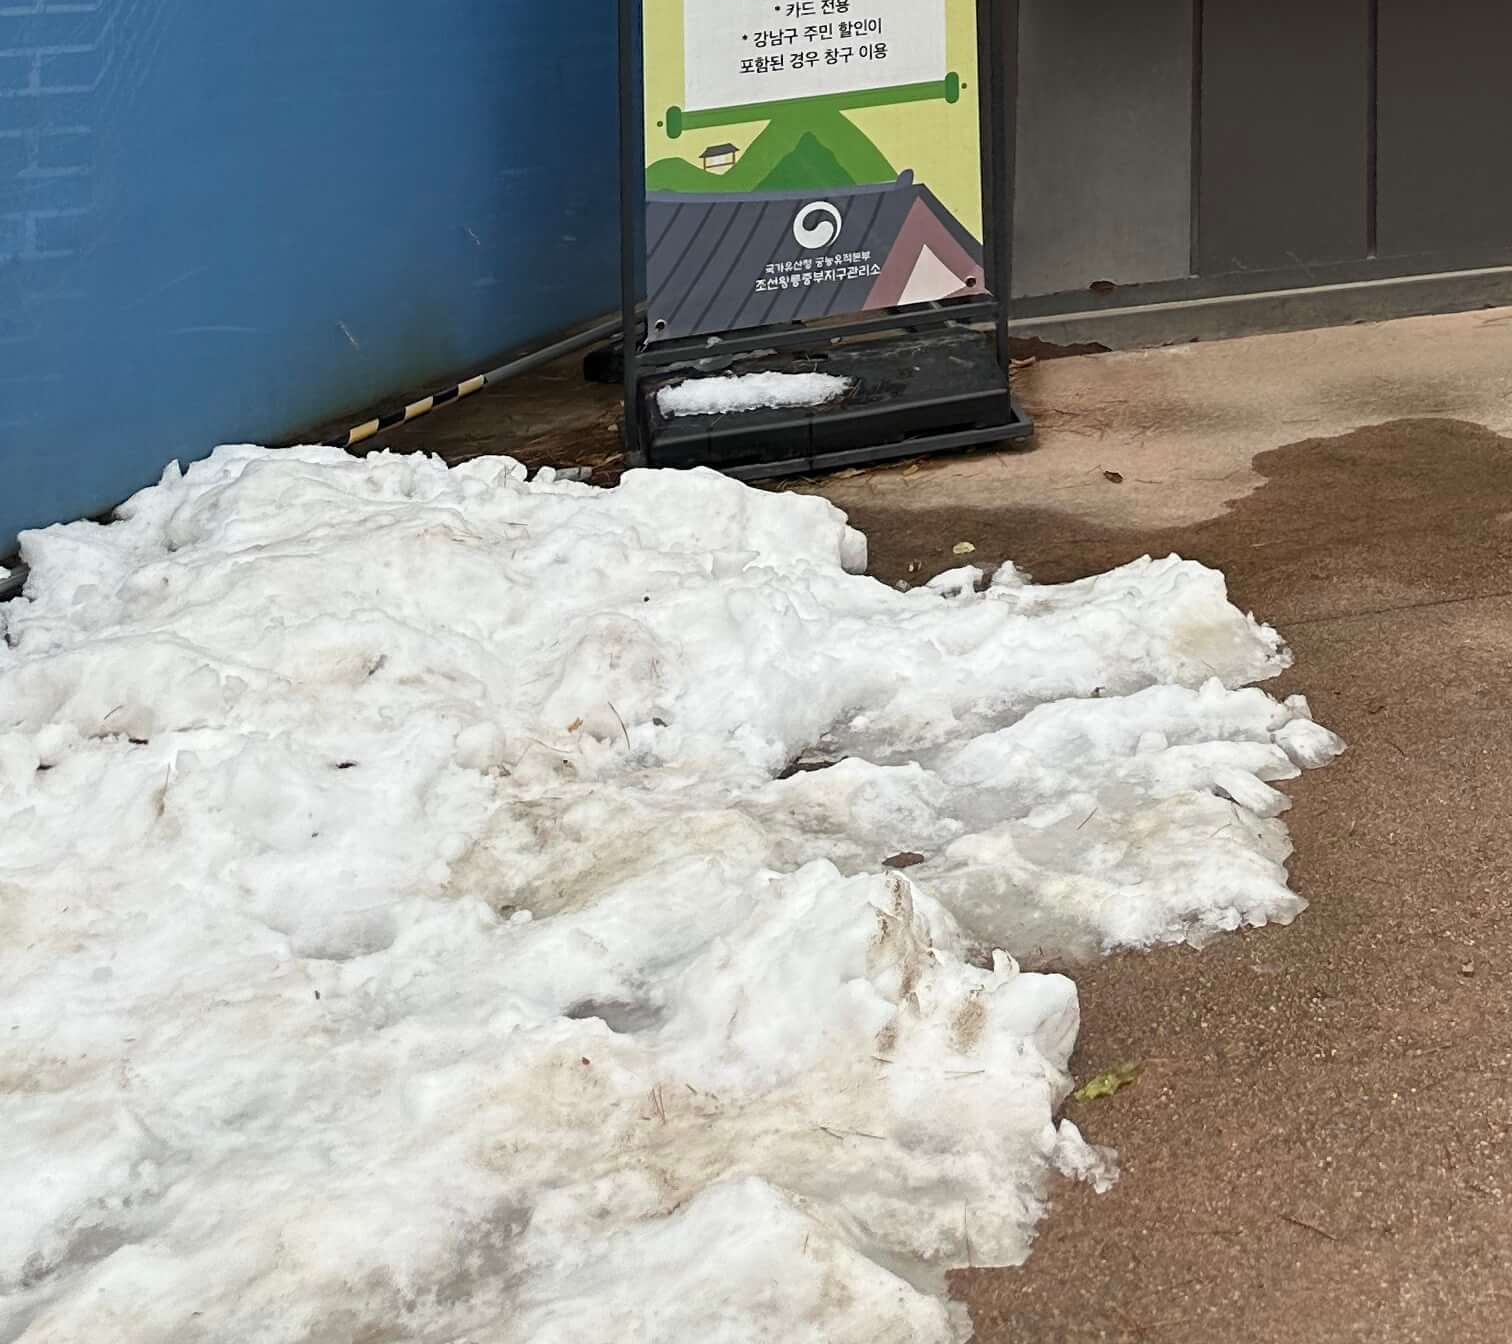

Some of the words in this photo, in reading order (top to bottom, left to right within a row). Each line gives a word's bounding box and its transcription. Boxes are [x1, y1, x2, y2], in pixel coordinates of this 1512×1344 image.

[786, 1, 818, 18] 카드
[754, 28, 798, 48] 강남구
[804, 23, 833, 42] 주민
[838, 18, 882, 39] 할인이
[740, 54, 785, 74] 포함된
[790, 51, 819, 69] 경우
[824, 47, 853, 65] 창구
[859, 43, 888, 60] 이용
[765, 259, 812, 274] 국가유산청
